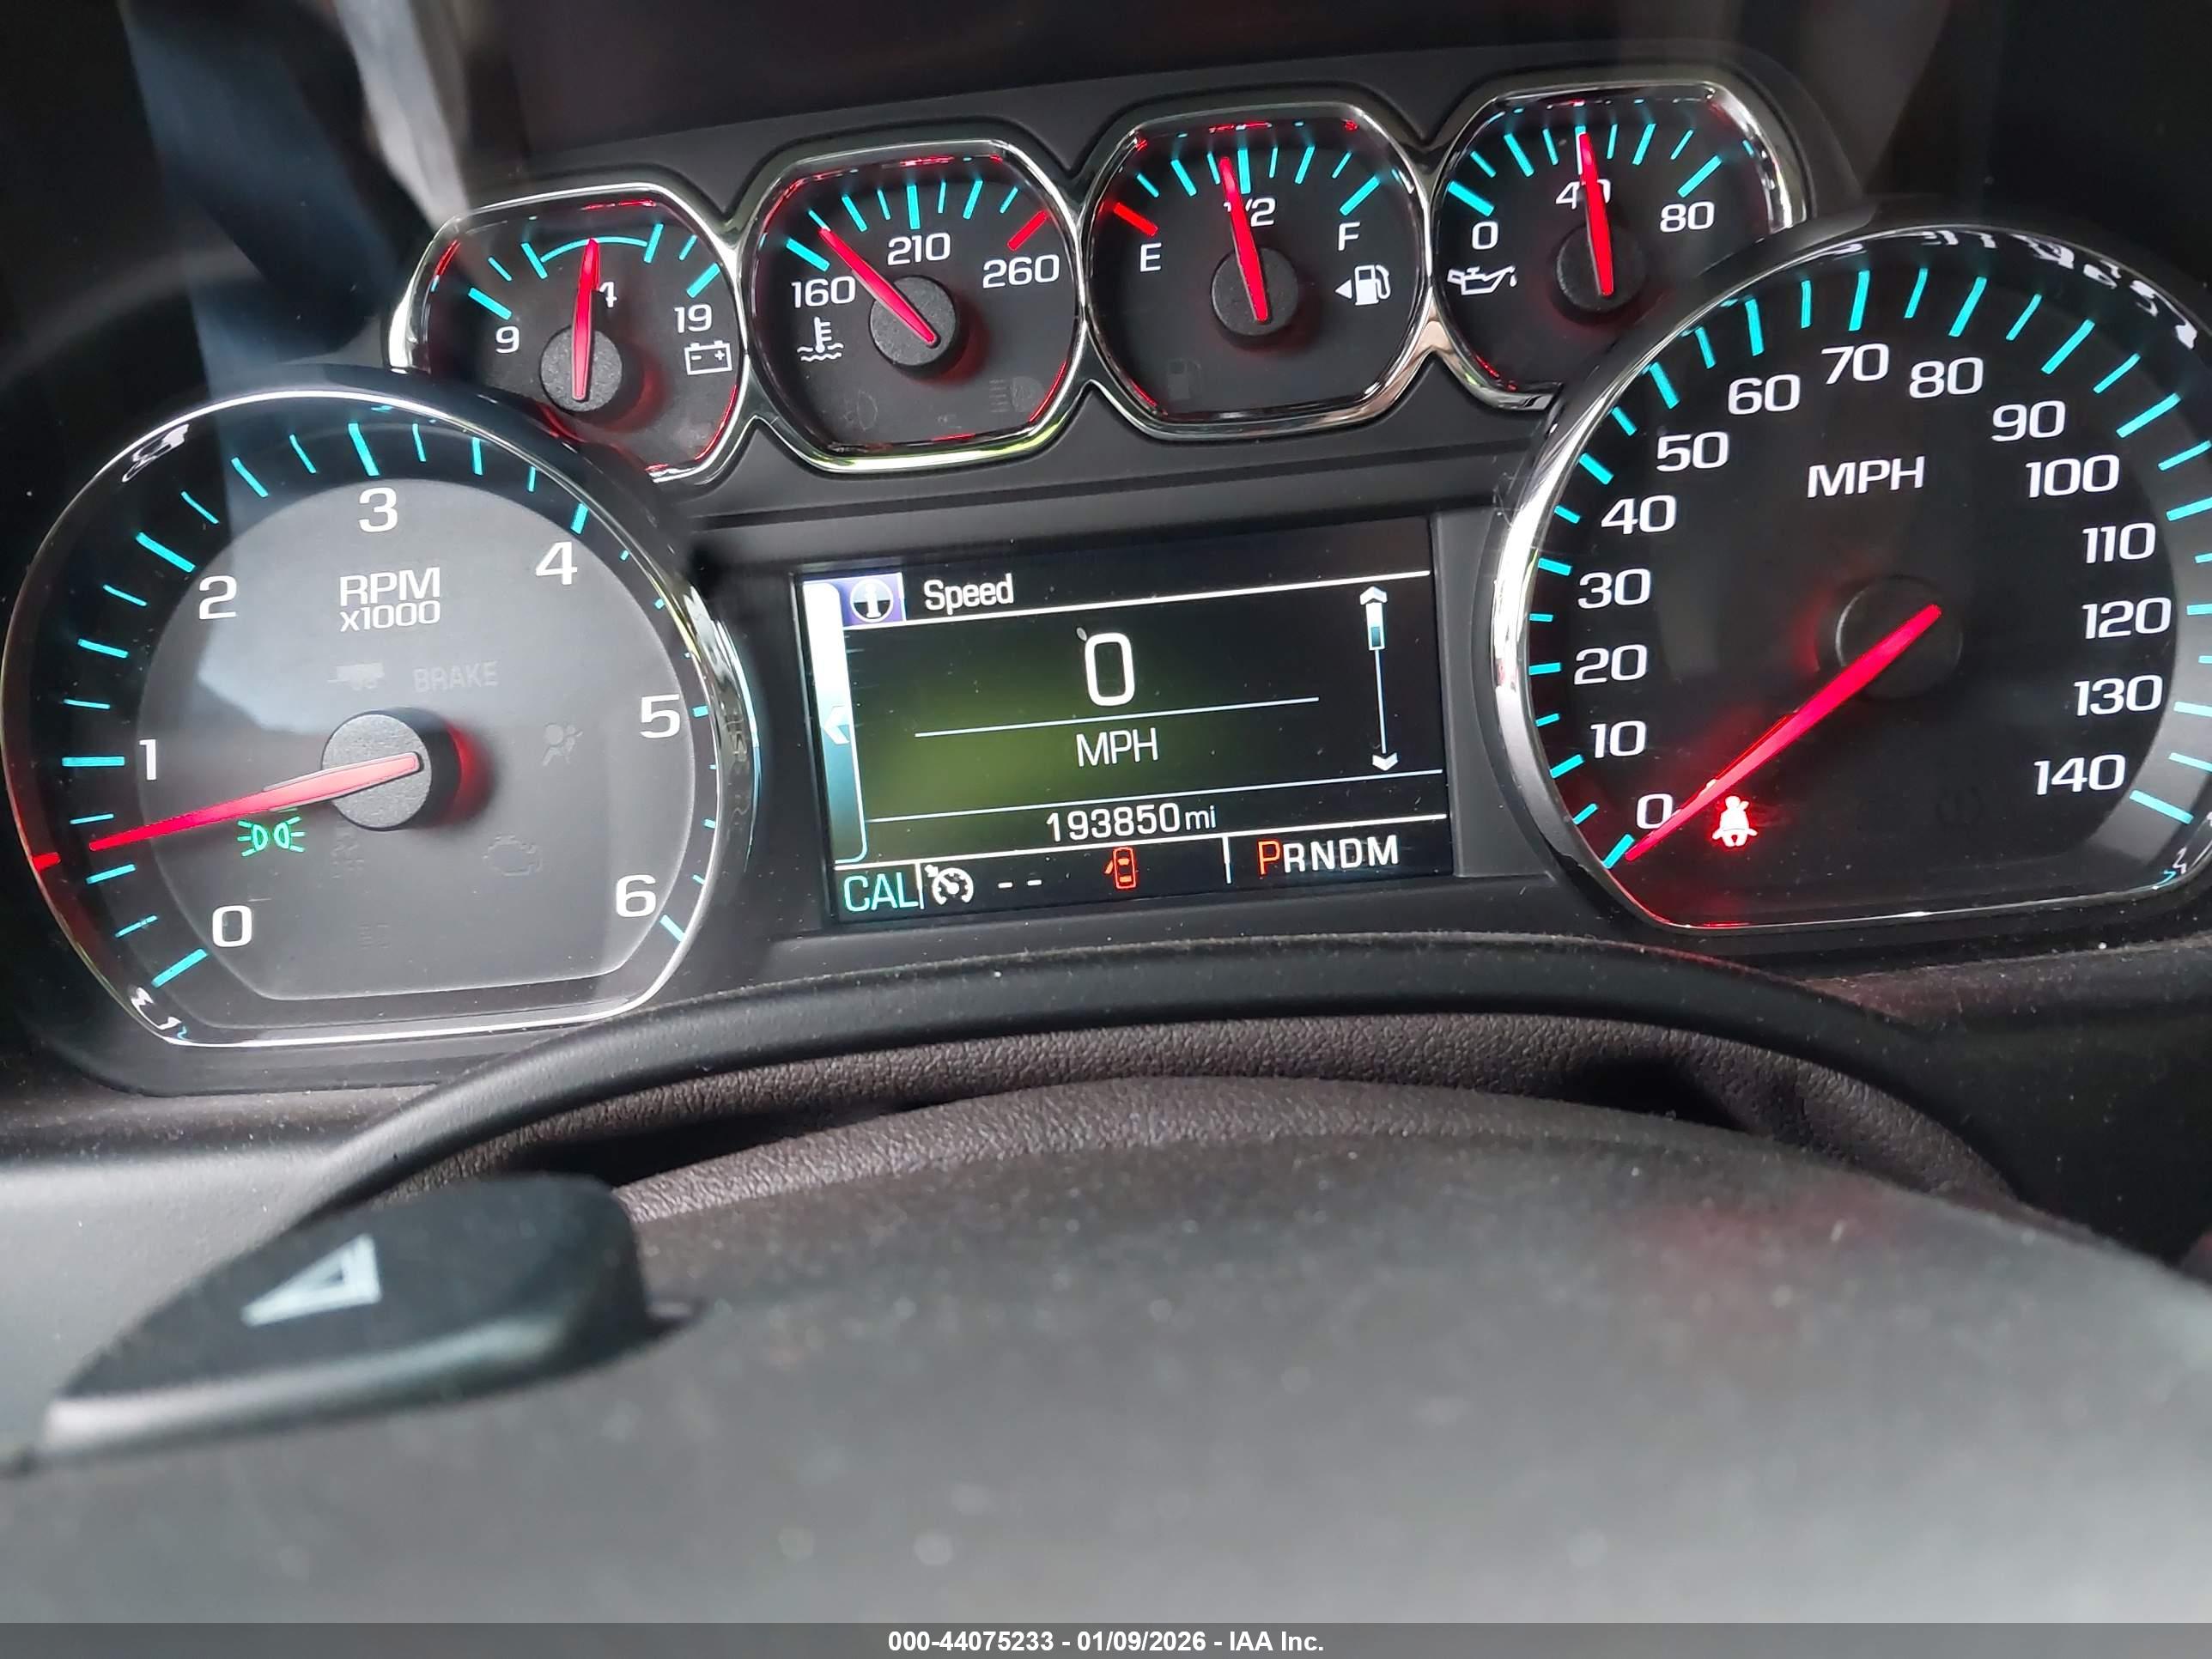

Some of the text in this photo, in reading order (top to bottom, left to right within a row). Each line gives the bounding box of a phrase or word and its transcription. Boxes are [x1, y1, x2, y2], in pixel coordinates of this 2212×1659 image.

[1338, 222, 1361, 252] F
[1472, 221, 1498, 250] 0
[1660, 201, 1715, 233] 80
[887, 232, 951, 265] 210
[1139, 242, 1162, 272] E
[791, 276, 856, 308] 160
[982, 254, 1060, 289] 260
[674, 304, 712, 333] 19
[495, 325, 520, 354] 9
[1821, 343, 1889, 385] 70
[1909, 356, 1984, 398] 80
[1728, 374, 1801, 415] 60
[1991, 400, 2066, 442] 90
[1656, 431, 1729, 472] 50
[1808, 456, 1925, 498] MPH
[2026, 454, 2120, 498] 100
[359, 487, 398, 532] 3
[1601, 495, 1676, 535] 40
[535, 541, 578, 586] 4
[2082, 522, 2156, 564] 110
[199, 575, 239, 620] 2
[339, 566, 441, 606] RPM
[923, 572, 1015, 617] Speed
[1577, 568, 1651, 609] 30
[339, 599, 441, 633] x1000
[2082, 597, 2172, 640] 120
[412, 659, 499, 694] BRAKE
[1083, 632, 1136, 708] 0
[1574, 644, 1648, 685] 20
[640, 693, 681, 738] 5
[2074, 674, 2163, 716] 130
[139, 738, 157, 781] 1
[1076, 727, 1158, 767] MPH
[1590, 720, 1647, 758] 10
[2033, 754, 2126, 795] 140
[1635, 793, 1674, 830] 0
[615, 874, 657, 919] 6
[843, 872, 917, 913] CAL
[212, 905, 252, 947] 0
